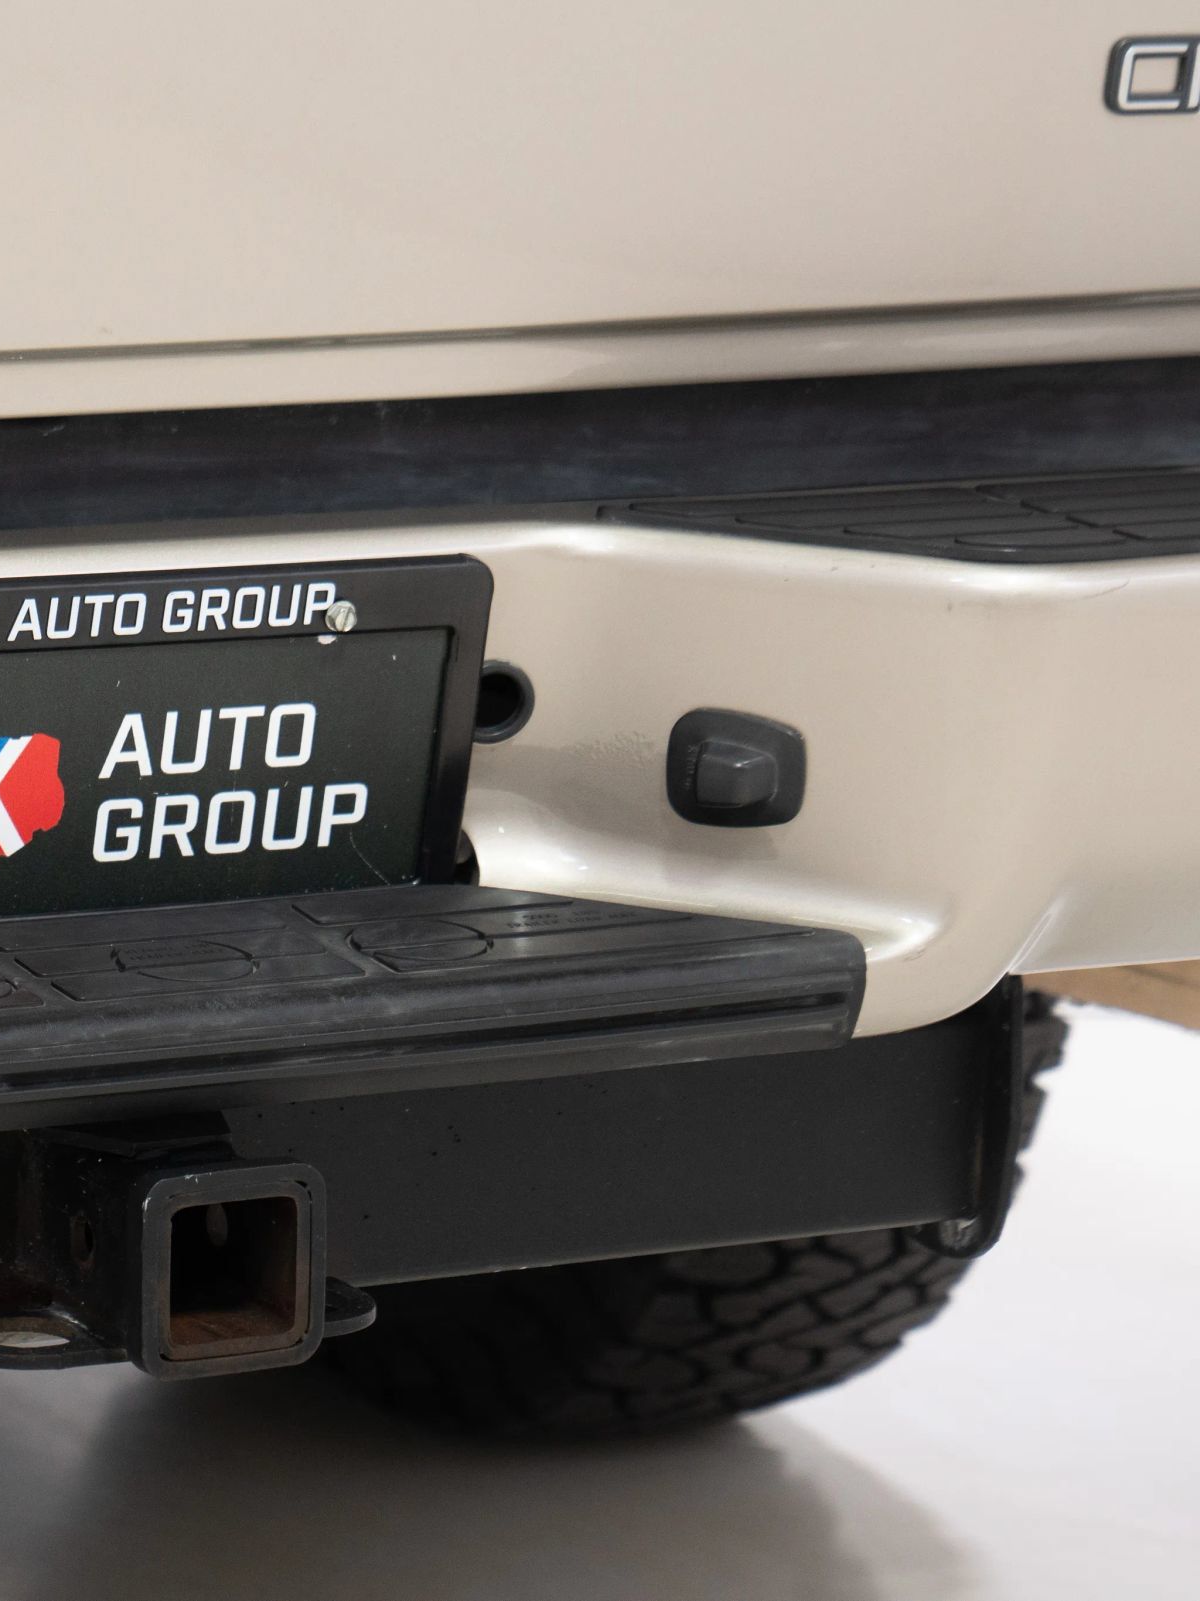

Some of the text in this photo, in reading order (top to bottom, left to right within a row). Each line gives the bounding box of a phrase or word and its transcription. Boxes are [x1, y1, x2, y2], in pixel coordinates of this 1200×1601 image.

[6, 592, 148, 642] AUTO
[161, 581, 337, 634] GROUP
[97, 701, 318, 780] AUTO
[91, 782, 368, 863] GROUP
